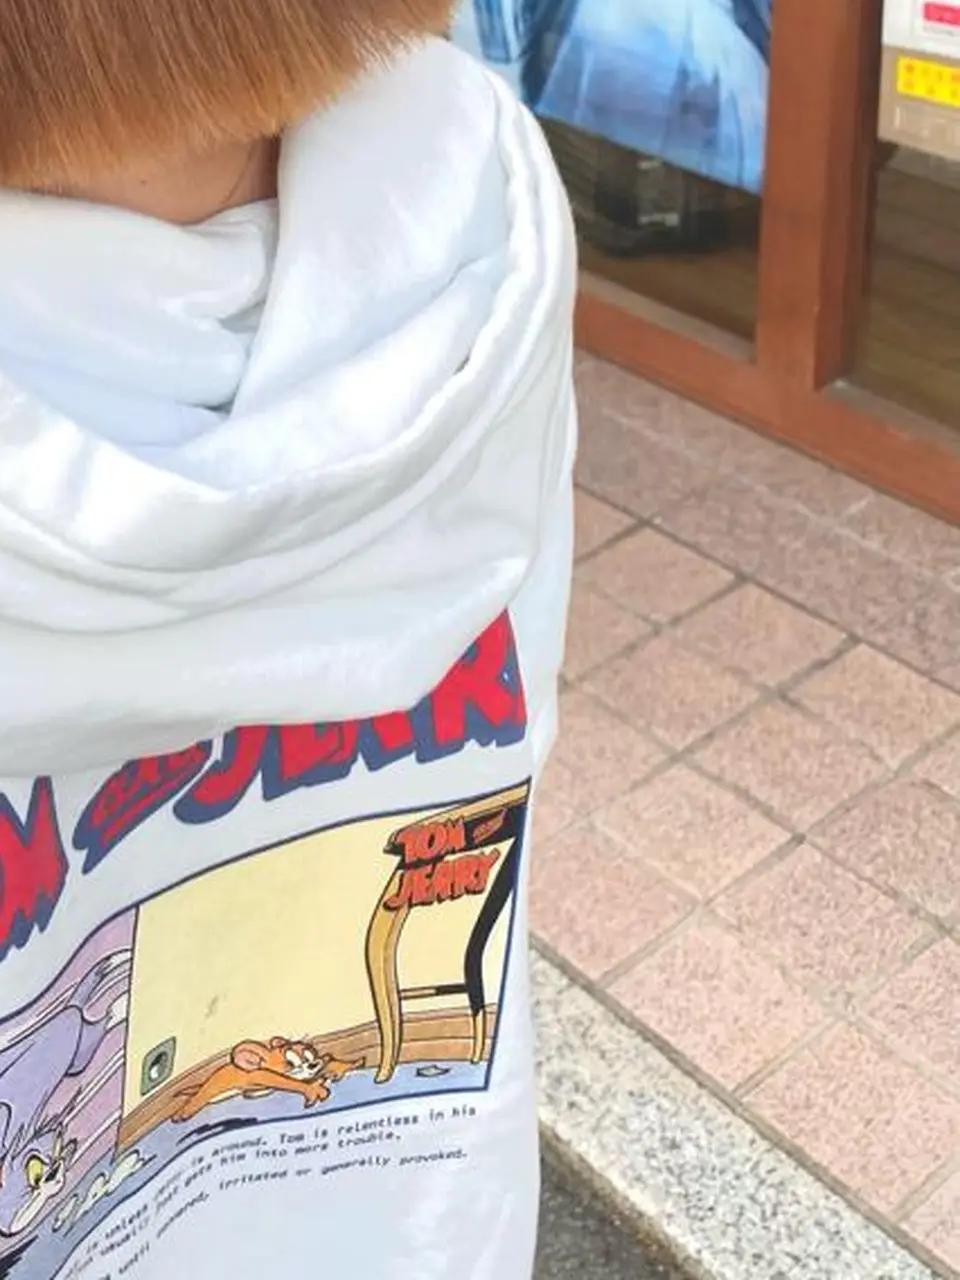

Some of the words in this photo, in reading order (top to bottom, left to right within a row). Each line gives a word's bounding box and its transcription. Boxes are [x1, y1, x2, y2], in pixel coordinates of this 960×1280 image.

[385, 816, 467, 866] TOM
[383, 847, 501, 910] JERRY
[338, 1114, 420, 1136] relentless
[429, 1108, 445, 1122] in
[452, 1104, 477, 1118] his
[255, 1146, 288, 1159] into
[219, 1169, 289, 1190] irritated
